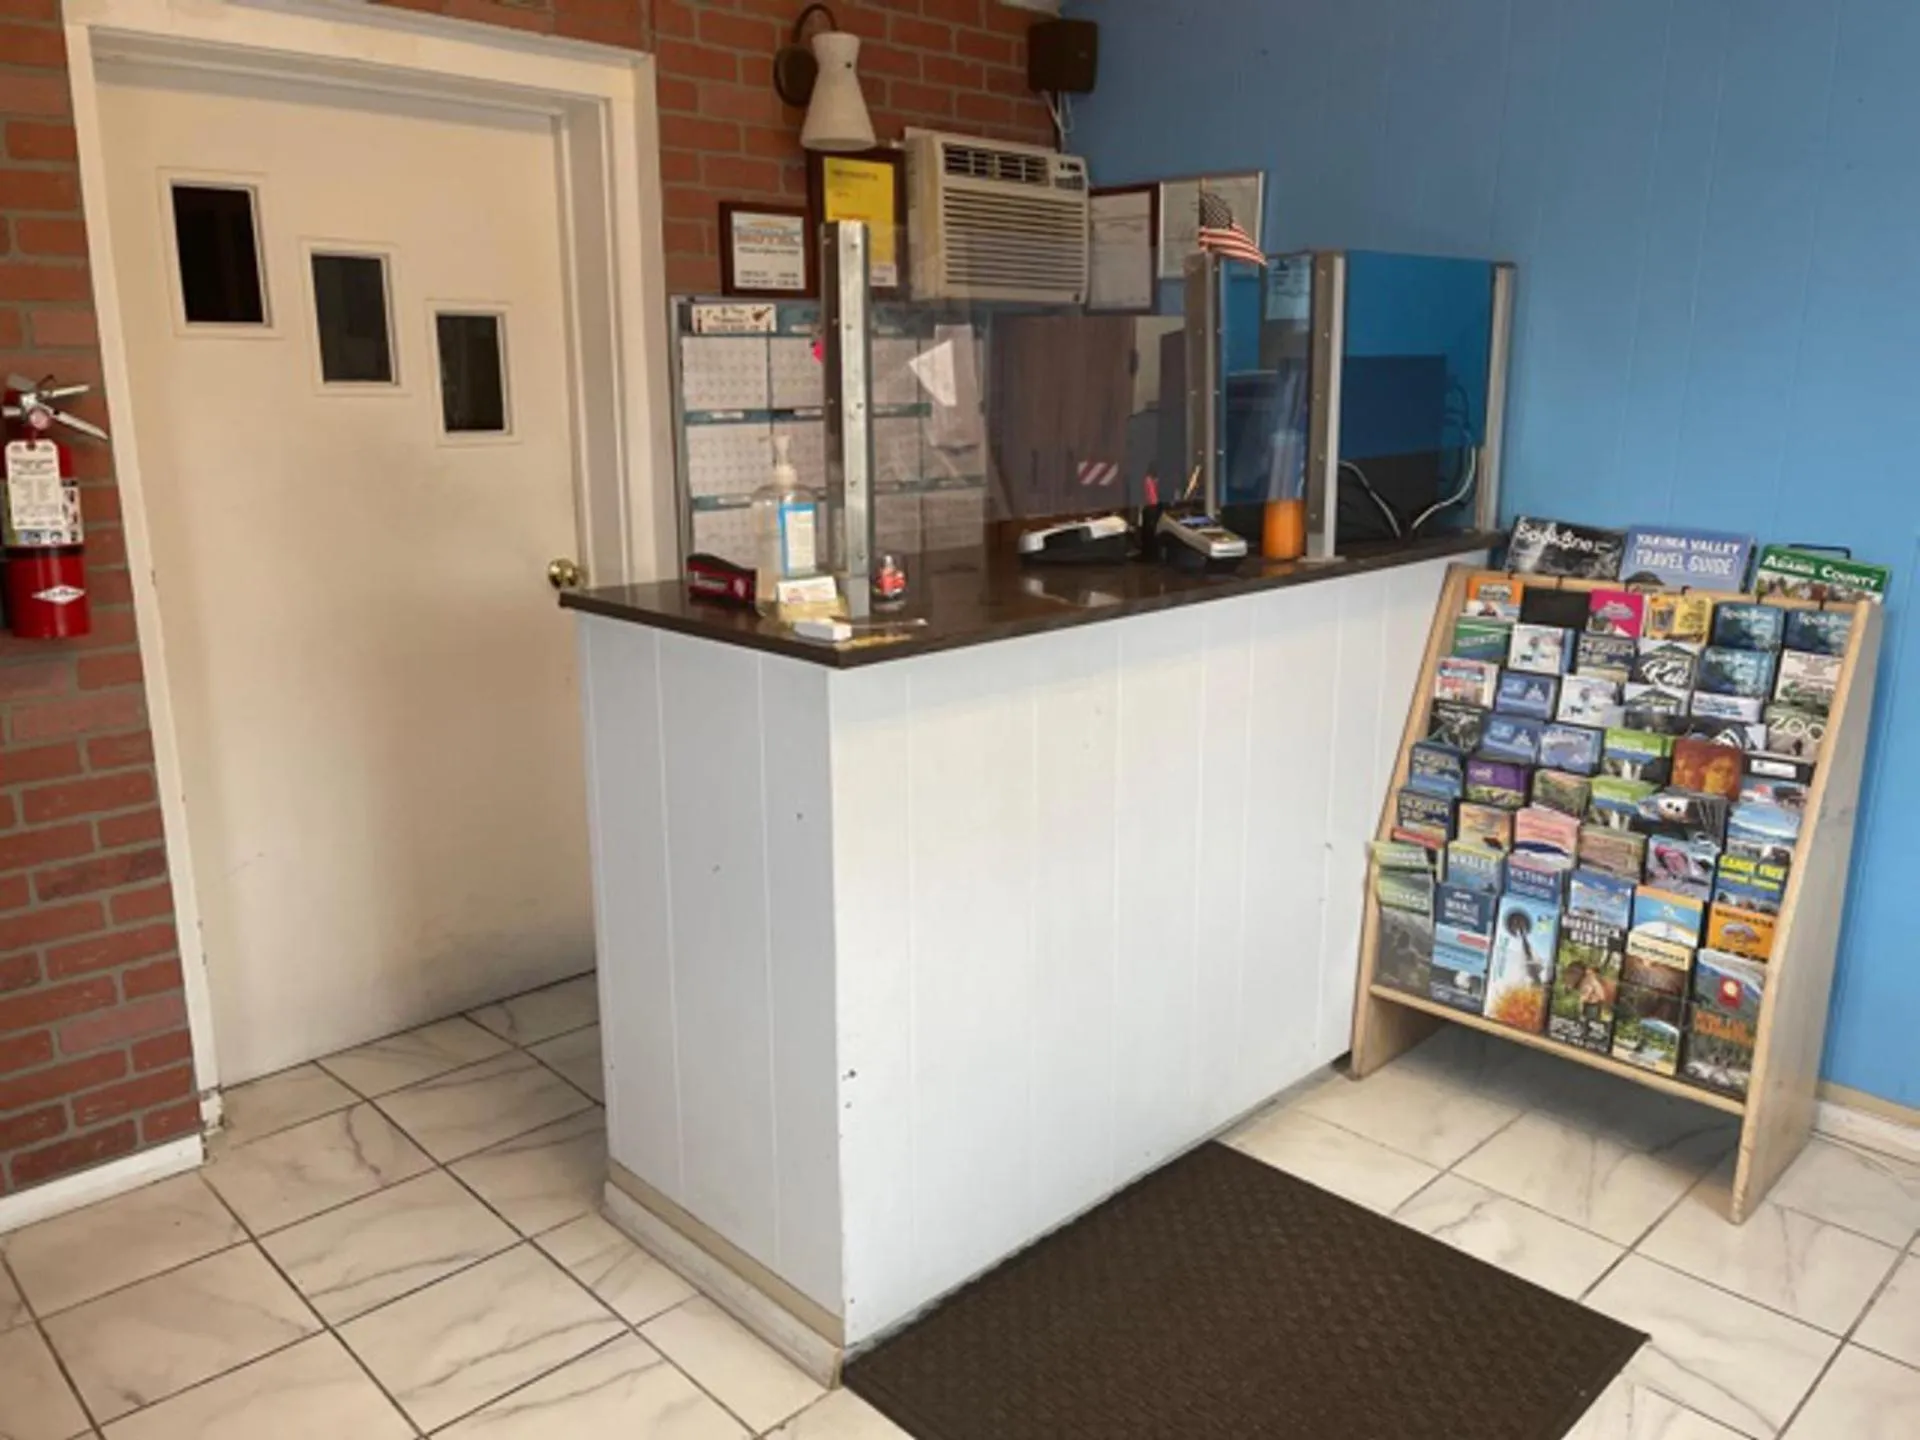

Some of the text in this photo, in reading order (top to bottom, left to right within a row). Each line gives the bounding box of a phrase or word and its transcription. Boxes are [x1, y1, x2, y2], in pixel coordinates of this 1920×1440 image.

[1690, 538, 1740, 554] VALLEY
[1636, 548, 1734, 576] TRAVEL GUIDE
[1821, 565, 1879, 587] COUNTY
[1770, 714, 1825, 743] ZOO
